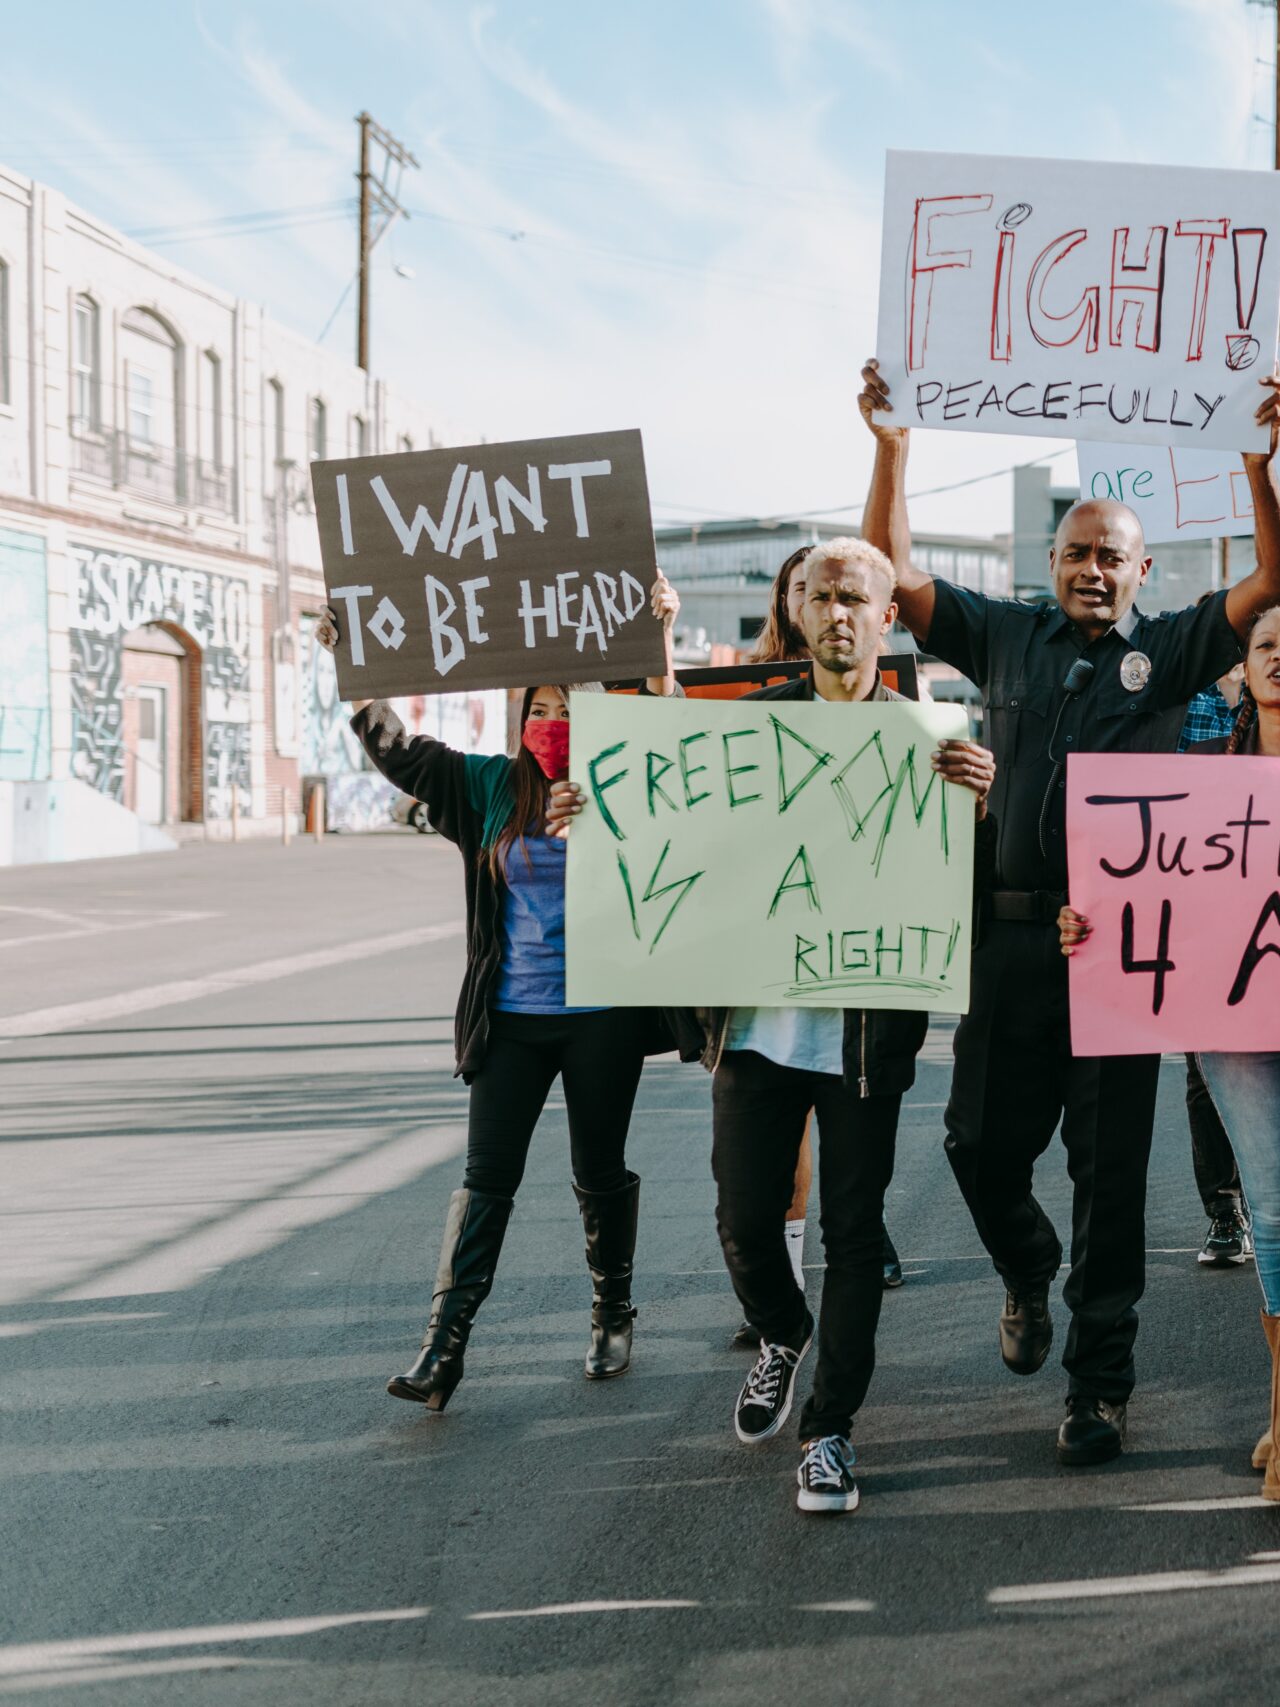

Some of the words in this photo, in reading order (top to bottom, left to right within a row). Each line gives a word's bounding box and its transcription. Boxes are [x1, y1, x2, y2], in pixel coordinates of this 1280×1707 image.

[905, 194, 1267, 378] FIGHT!
[916, 380, 1227, 431] PEACEFULLY
[336, 474, 356, 556] I
[369, 460, 611, 560] WANT
[1090, 467, 1154, 503] are
[66, 546, 208, 650] ESCAPE
[330, 585, 407, 667] TO
[424, 574, 490, 676] BE
[518, 570, 645, 653] HEARD
[587, 712, 951, 879] FREEDOM
[616, 838, 706, 956] IS
[767, 844, 822, 920] A
[794, 918, 962, 983] RIGHT!
[1120, 898, 1177, 1017] 4
